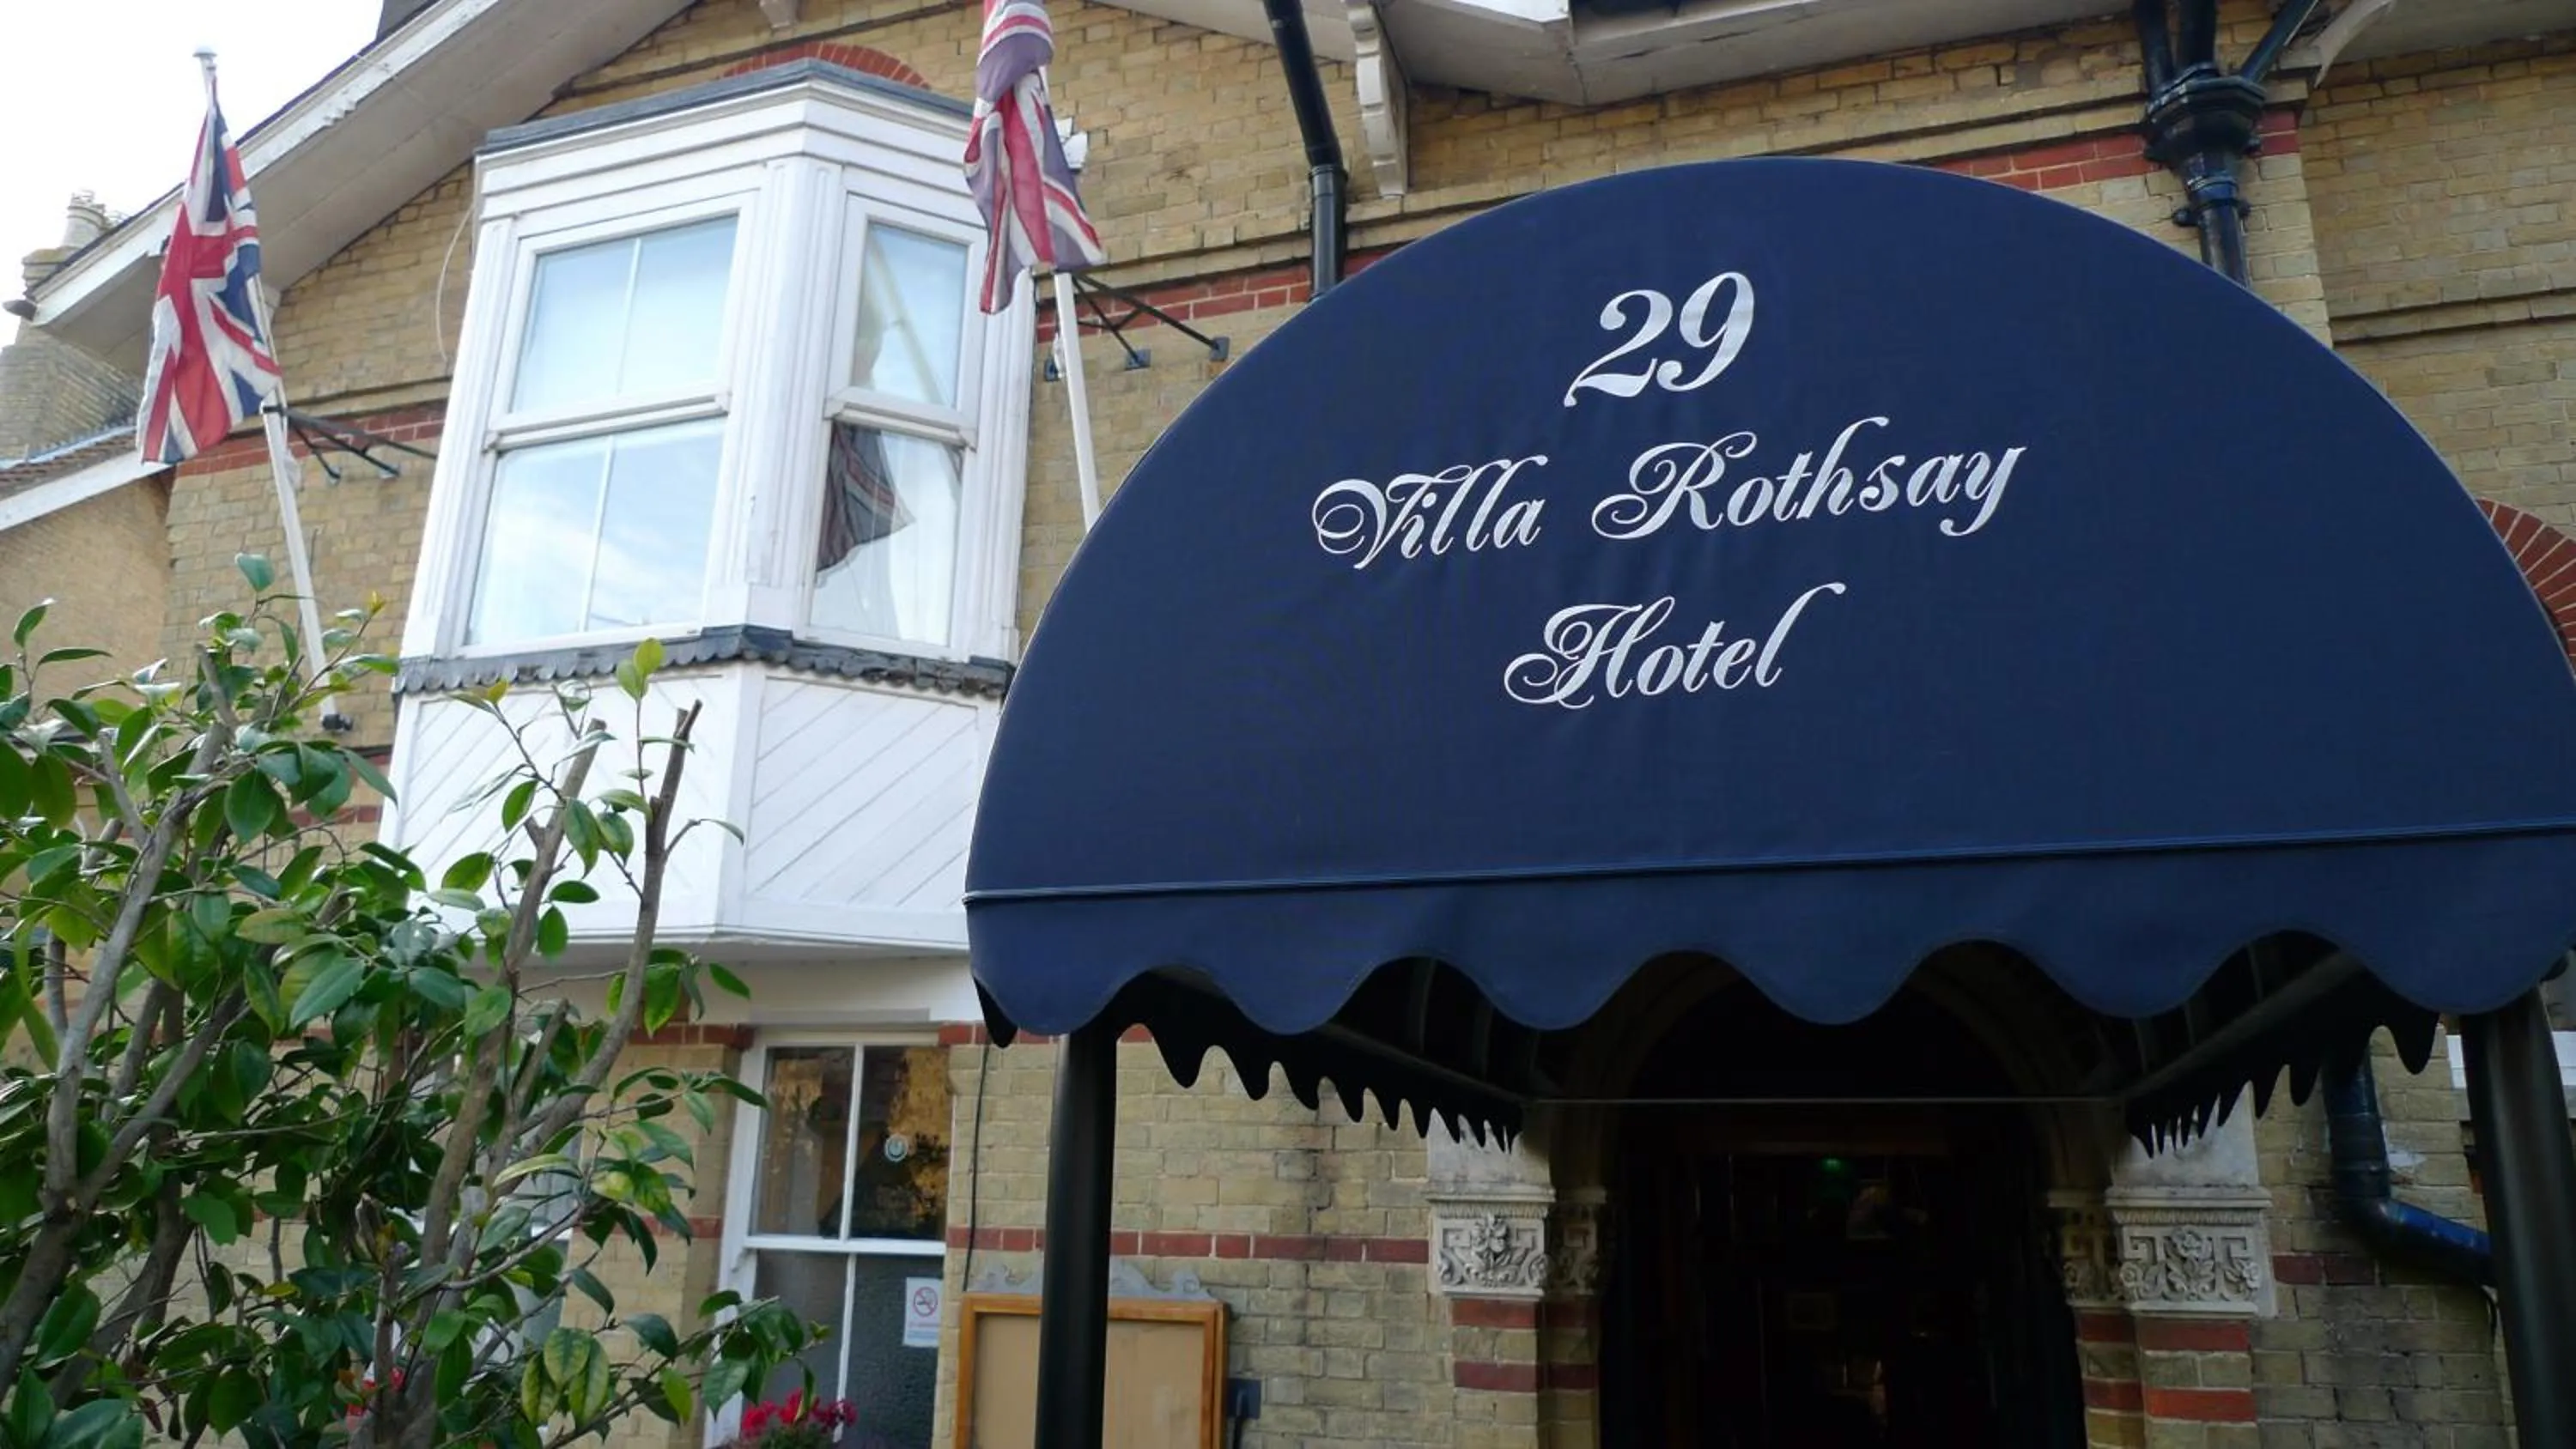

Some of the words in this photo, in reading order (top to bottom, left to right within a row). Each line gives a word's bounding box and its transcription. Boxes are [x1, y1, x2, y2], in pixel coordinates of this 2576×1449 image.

[1564, 271, 1754, 407] 29
[1311, 454, 1548, 570] Villa
[1591, 416, 2027, 540] Rothsay
[1504, 582, 1846, 709] Hotel
